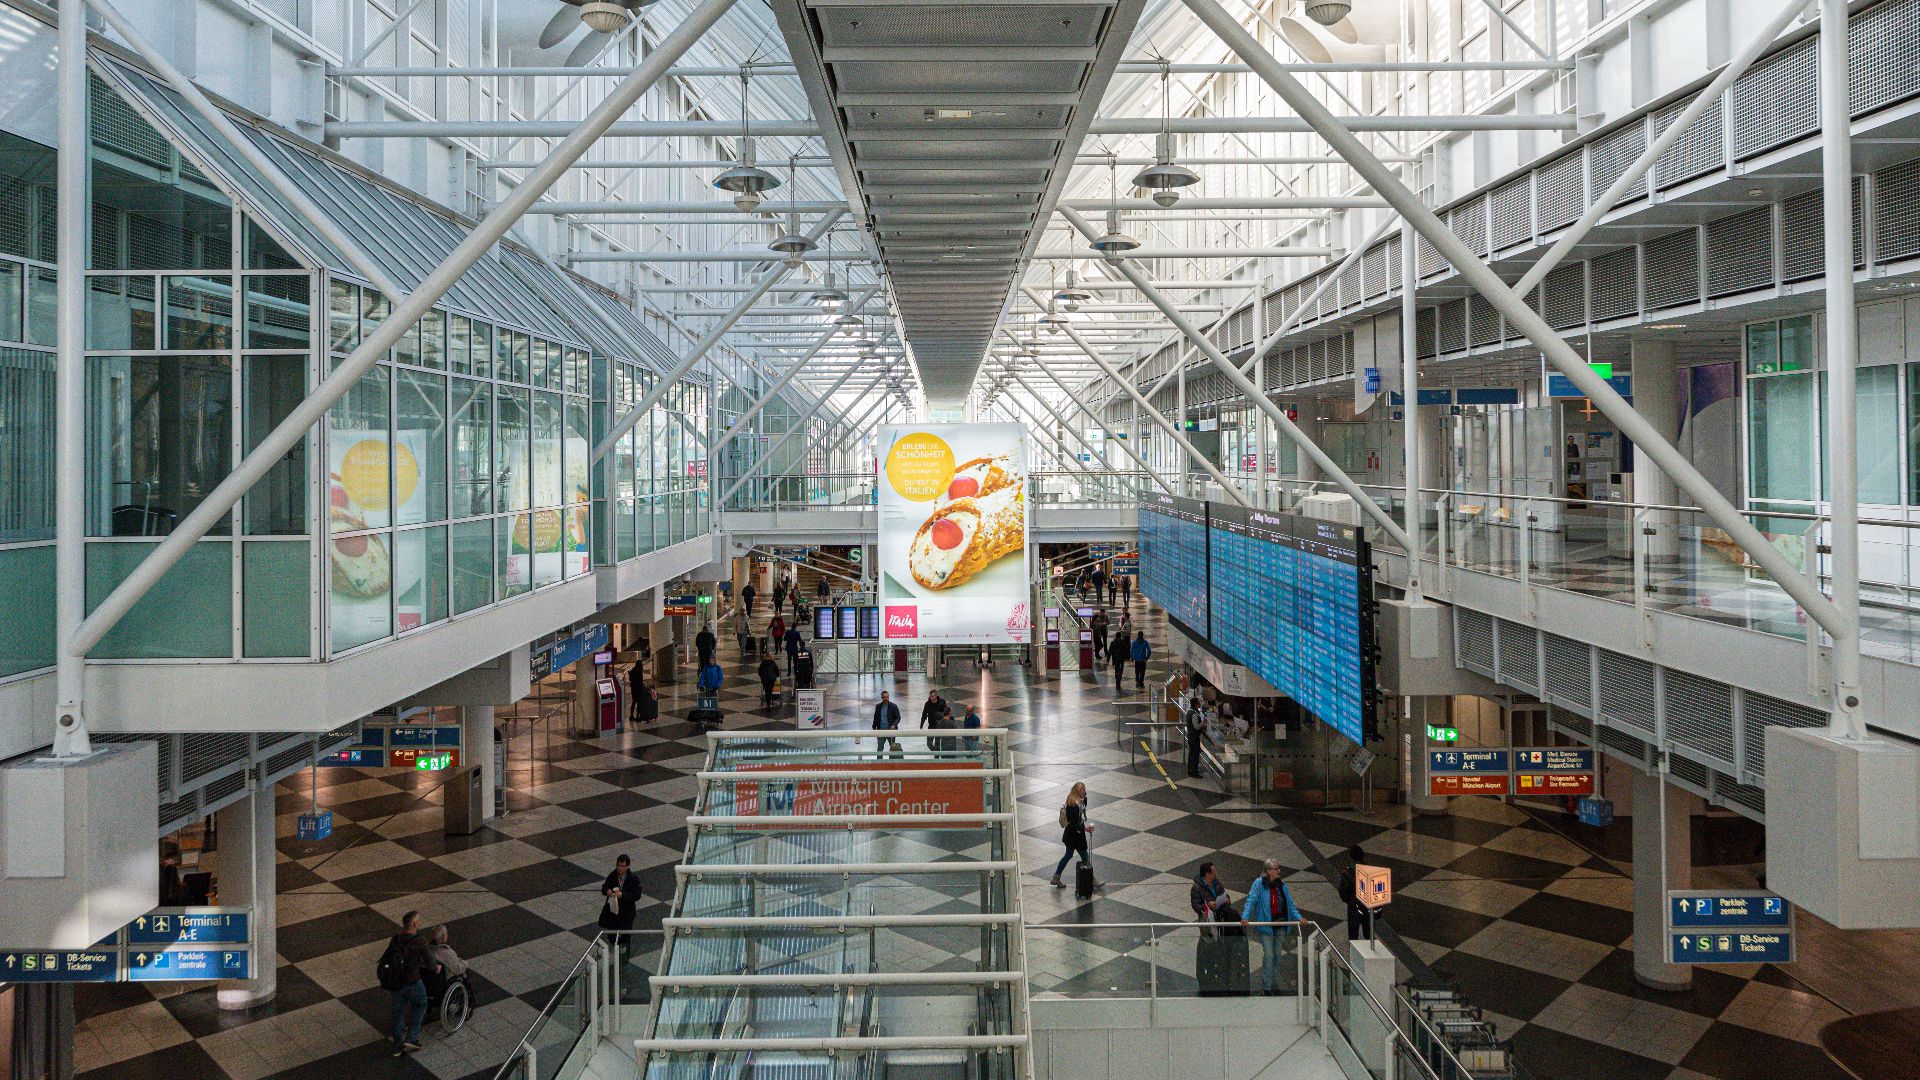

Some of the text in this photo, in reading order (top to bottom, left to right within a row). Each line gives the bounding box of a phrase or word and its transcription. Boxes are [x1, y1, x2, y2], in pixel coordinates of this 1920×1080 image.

[895, 450, 945, 459] SCHÖNHEIT
[905, 487, 936, 495] ITALIEN
[849, 548, 862, 562] S
[888, 614, 915, 629] ITALIA
[1463, 752, 1492, 761] Terminal
[1462, 762, 1476, 770] A-E
[813, 797, 950, 816] Airport Center
[1581, 800, 1597, 817] Lift
[300, 818, 315, 830] Lift
[319, 815, 331, 829] Lift
[1720, 898, 1748, 907] Parkleit-
[177, 915, 230, 927] Terminal 1
[178, 929, 198, 941] A-E
[1739, 934, 1780, 943] DB-Service
[1739, 943, 1766, 952] Tickets
[66, 953, 107, 962] DB-Service
[177, 952, 207, 961] Parkleit-
[66, 962, 93, 971] Tickets
[177, 961, 207, 969] zentrale
